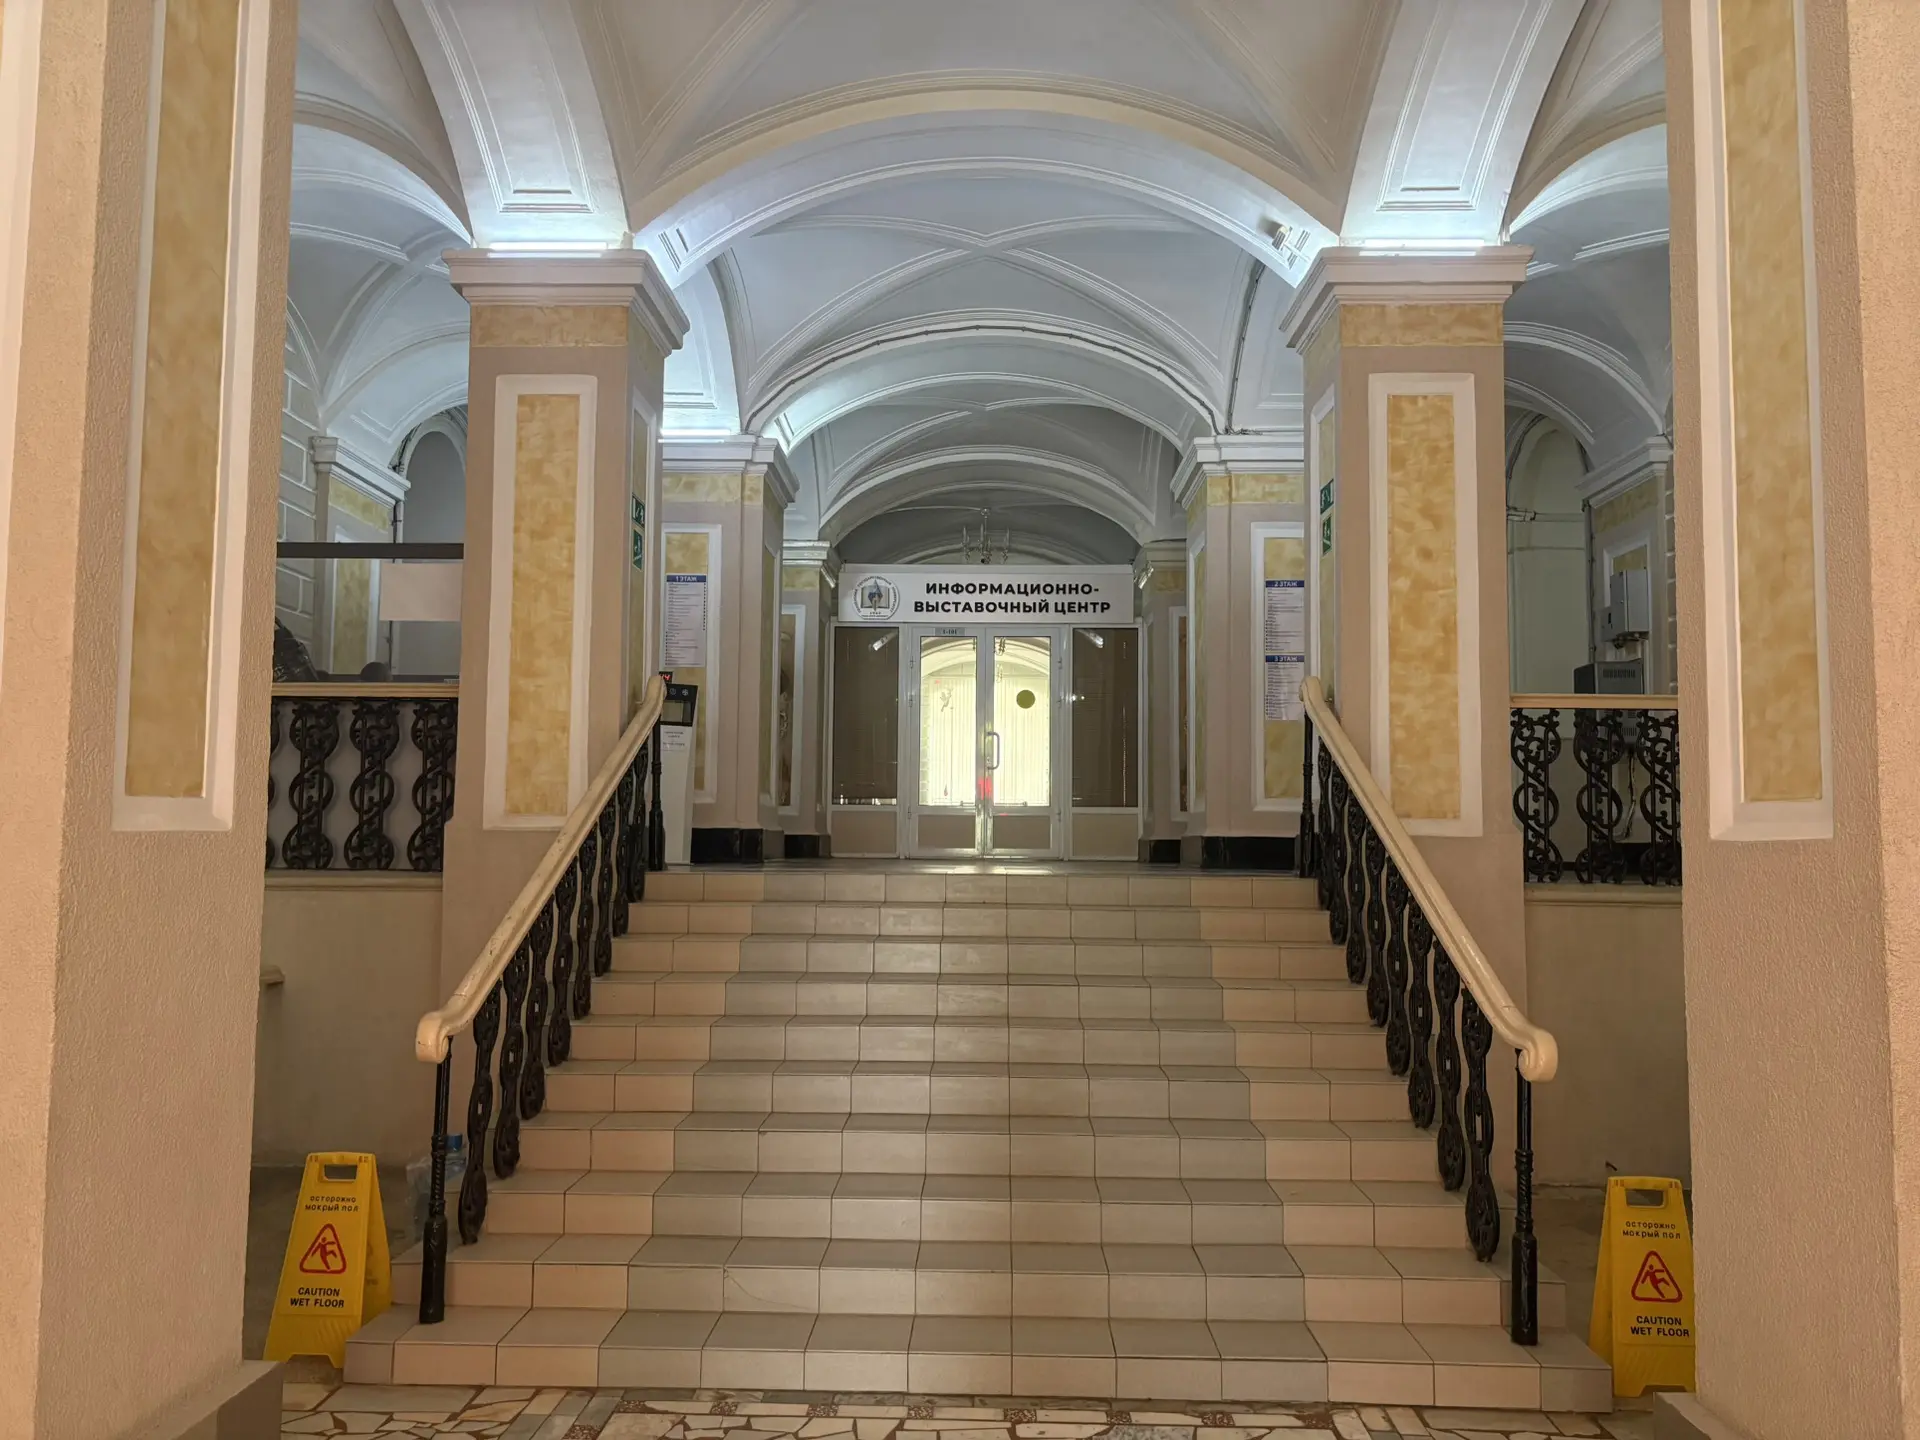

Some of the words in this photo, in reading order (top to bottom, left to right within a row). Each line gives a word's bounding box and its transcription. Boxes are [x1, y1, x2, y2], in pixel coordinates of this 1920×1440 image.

[925, 583, 1099, 597] ИНФОРМАЦИОННО-
[914, 599, 1049, 613] ВЫСТАВОЧНЫЙ
[1054, 601, 1111, 615] ЦЕНТР
[298, 1287, 340, 1296] CAUTION
[290, 1298, 310, 1307] WET
[314, 1299, 345, 1308] FLOOR
[1636, 1316, 1682, 1326] CAUTION
[1630, 1326, 1653, 1336] WET
[1657, 1327, 1690, 1337] FLOOR
